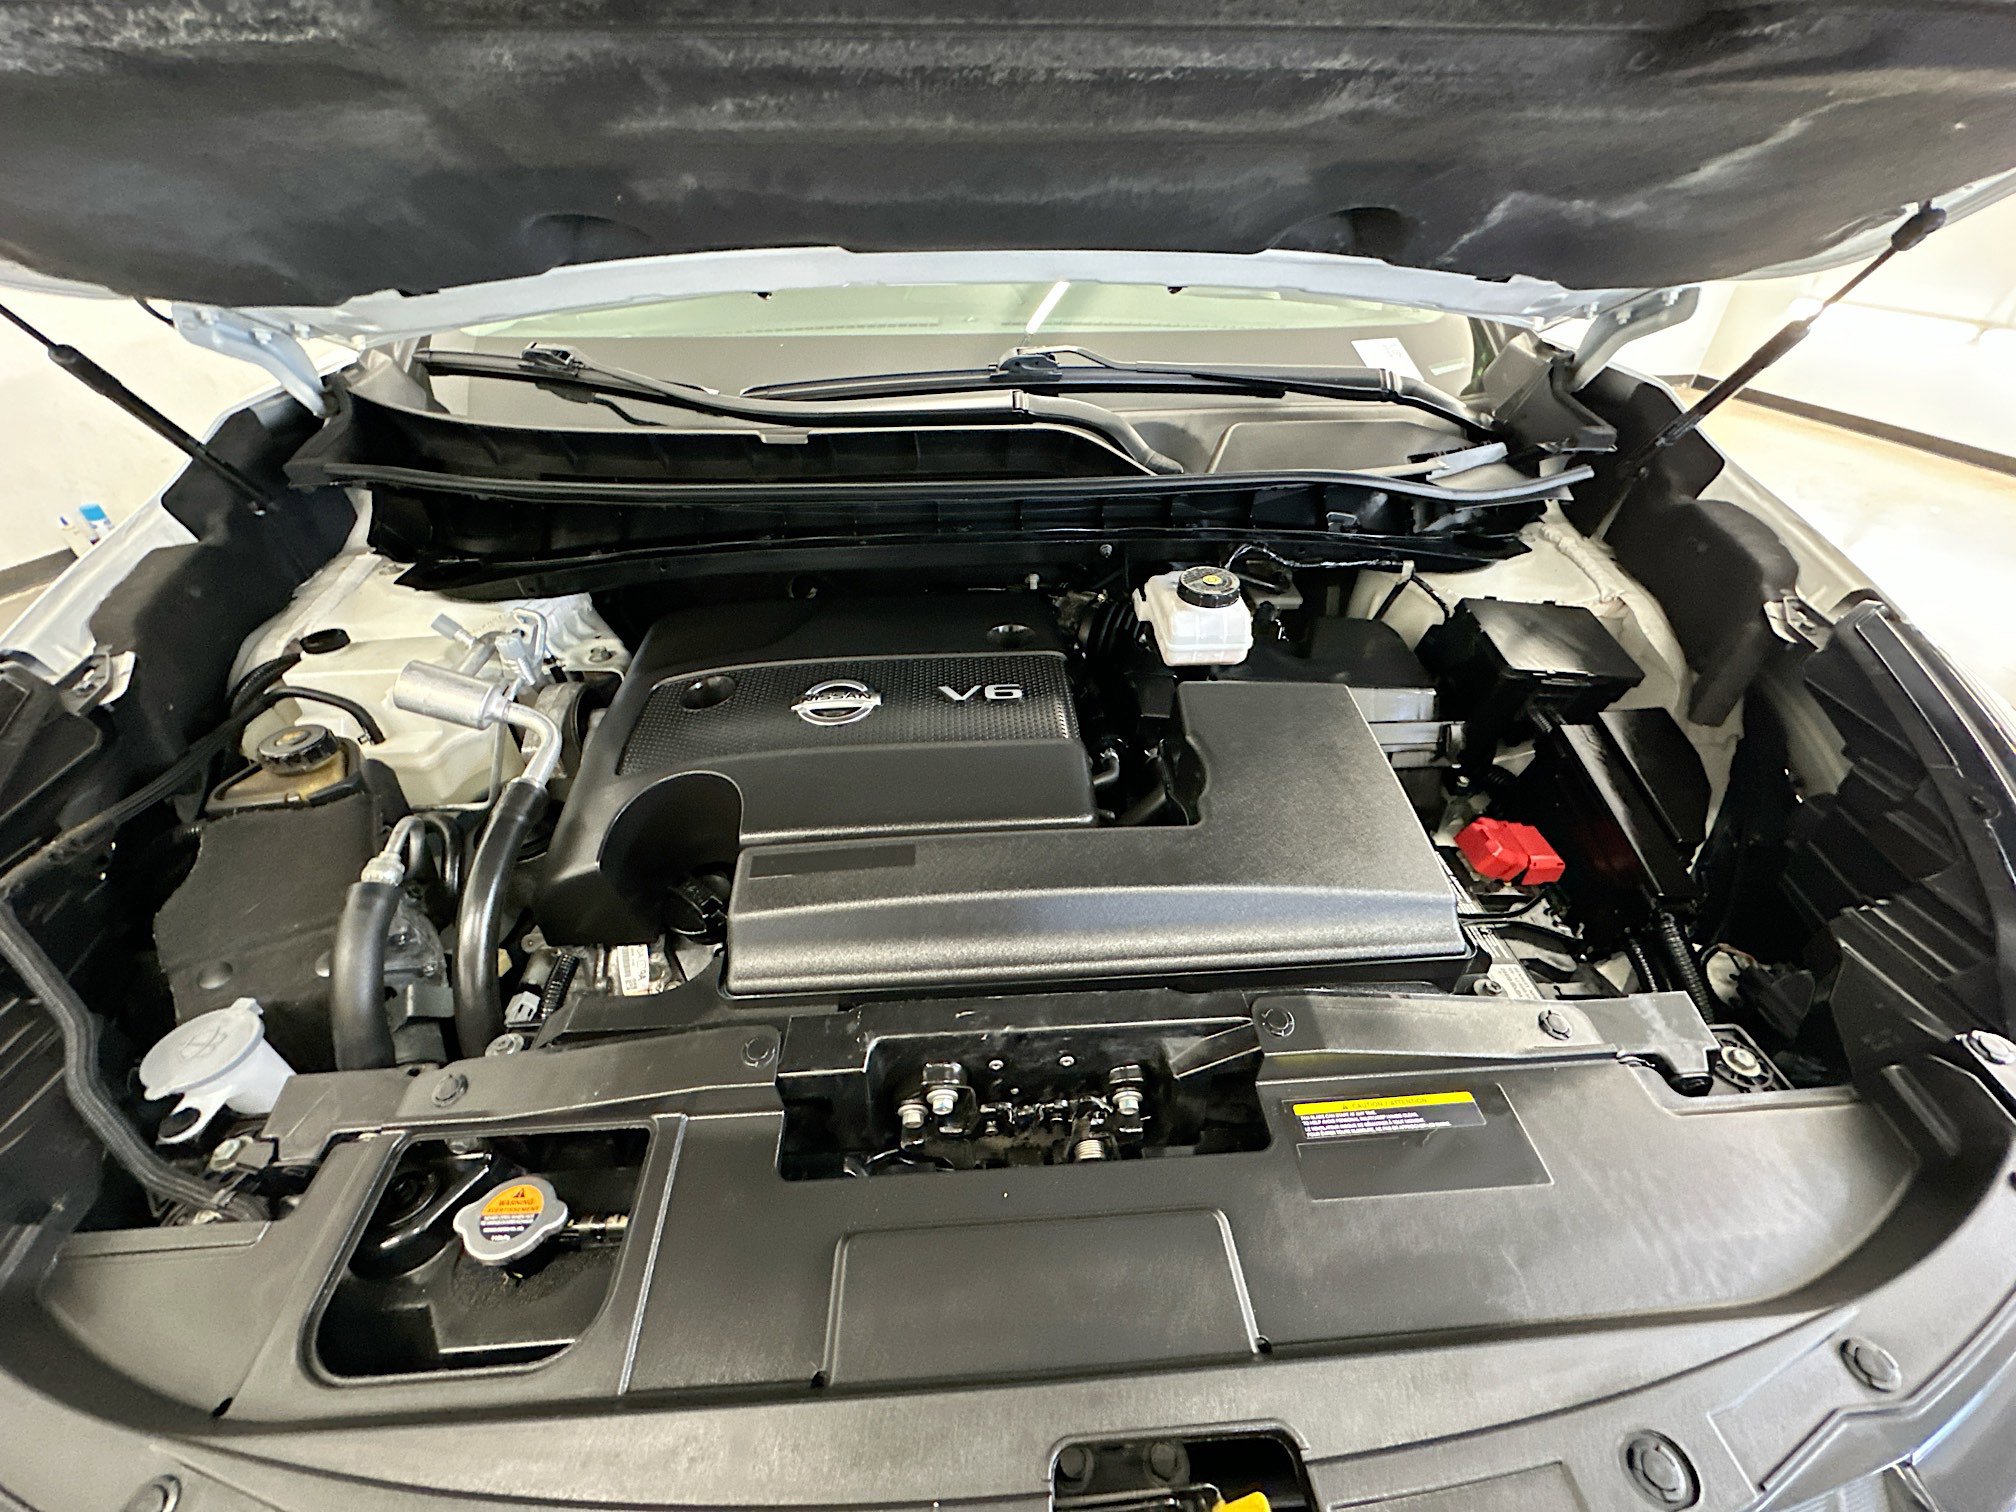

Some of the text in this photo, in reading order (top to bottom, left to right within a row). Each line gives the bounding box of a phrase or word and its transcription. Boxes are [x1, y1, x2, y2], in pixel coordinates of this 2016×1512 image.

[938, 684, 1022, 701] V6
[1352, 1101, 1383, 1109] CAUTION
[1391, 1098, 1427, 1106] ATTENTION
